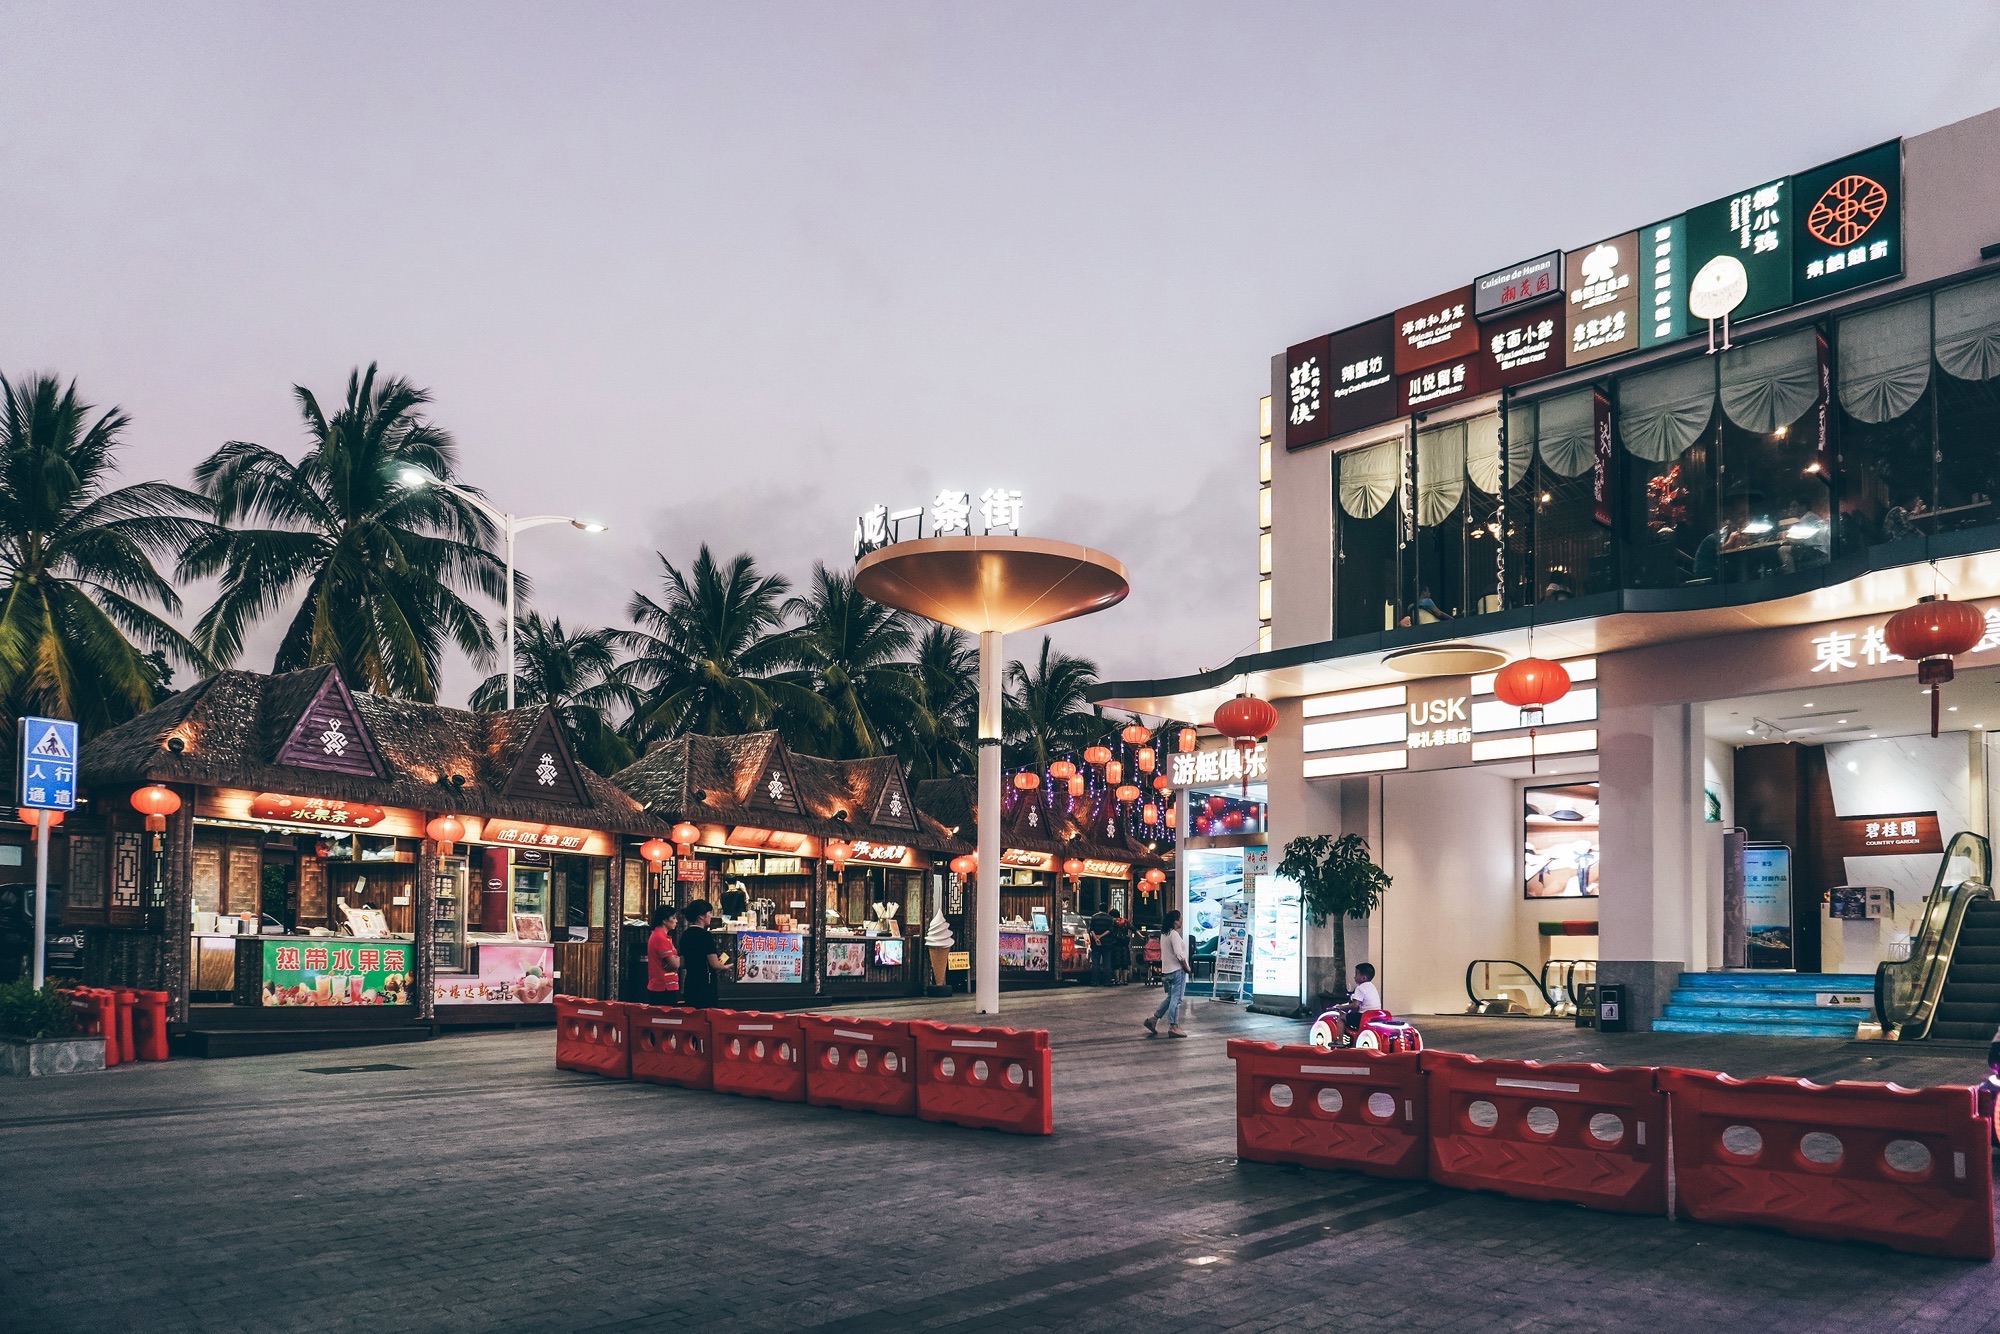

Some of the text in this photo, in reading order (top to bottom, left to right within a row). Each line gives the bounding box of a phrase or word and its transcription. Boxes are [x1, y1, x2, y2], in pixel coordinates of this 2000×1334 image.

[1481, 260, 1551, 290] Cuisine de Hunan
[1402, 303, 1466, 336] 海南私房菜
[1408, 363, 1466, 397] 川悦留香
[854, 488, 1023, 556] 小吃一条街
[1410, 697, 1467, 726] USK
[28, 764, 73, 783] 人行
[1172, 745, 1267, 785] 游艇俱乐
[28, 787, 72, 805] 通道
[290, 808, 350, 824] 水果茶
[276, 947, 405, 971] 热带水果茶
